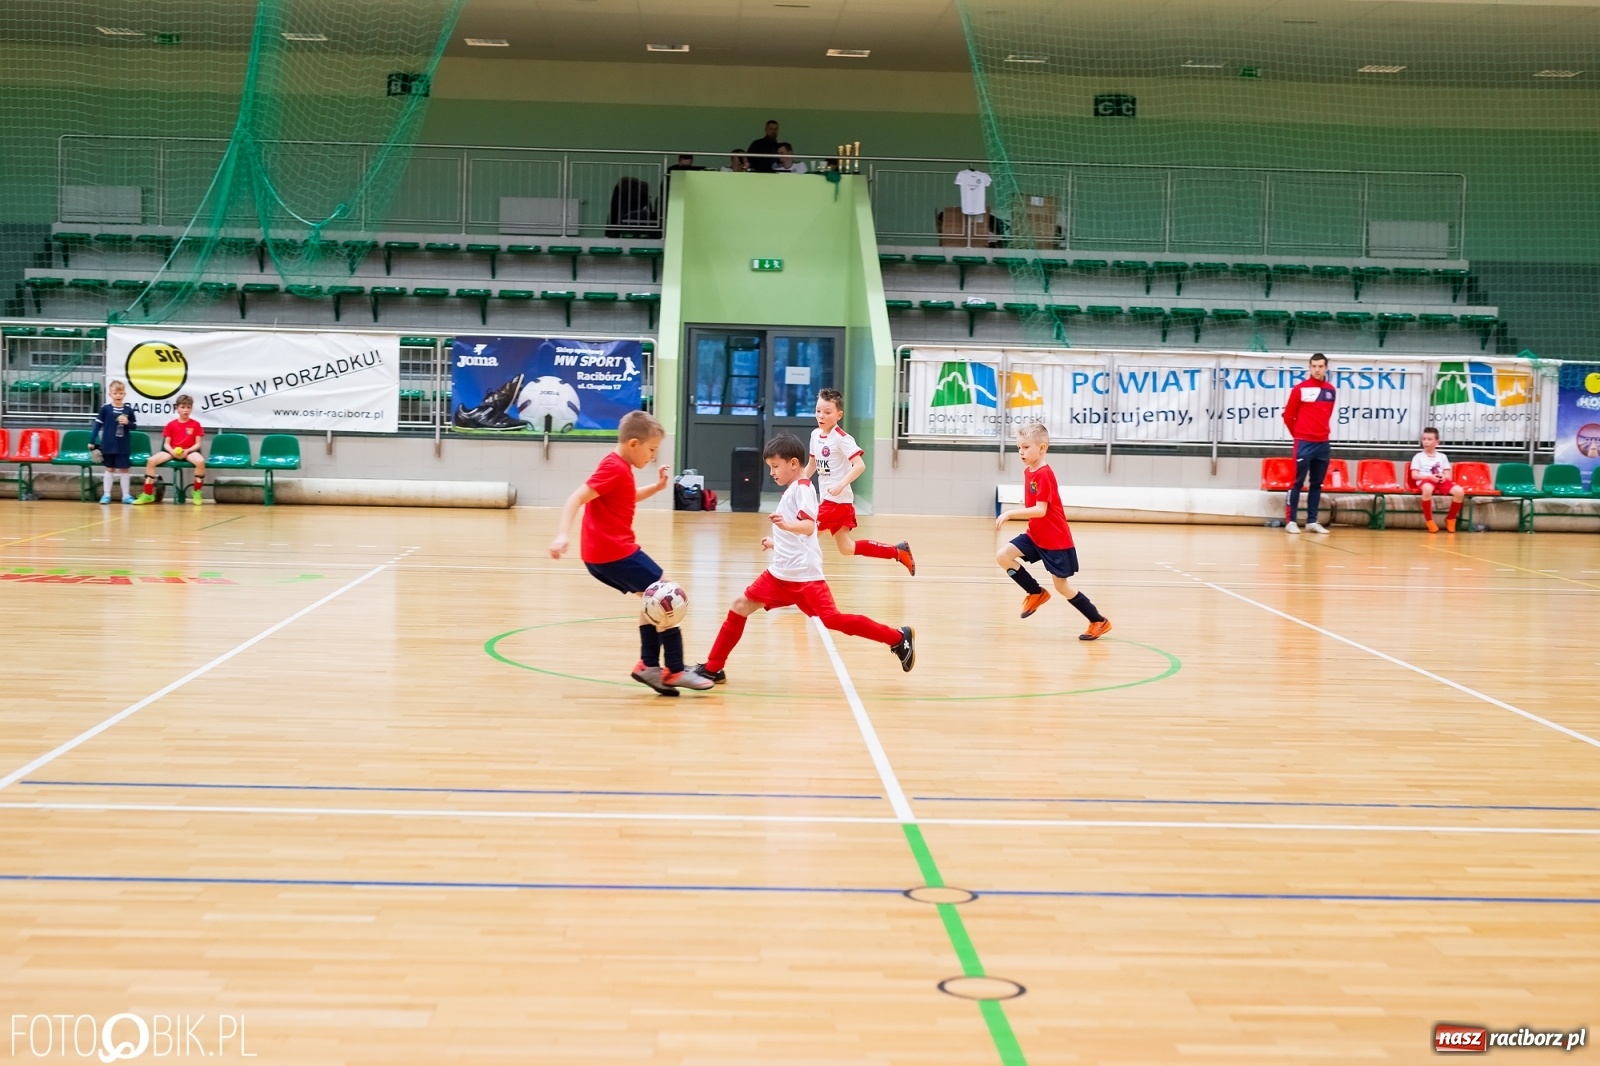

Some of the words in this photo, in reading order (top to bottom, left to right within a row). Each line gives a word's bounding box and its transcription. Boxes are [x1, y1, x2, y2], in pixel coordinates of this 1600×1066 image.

[554, 355, 578, 366] MW
[579, 356, 623, 367] SPORT
[201, 386, 244, 410] JEST
[249, 380, 267, 396] W
[272, 350, 382, 391] PORZĄDKU!
[577, 371, 622, 381] Racibórz
[1213, 367, 1406, 390] RACIBRSKI
[273, 408, 384, 420] www.osir-raciborz.pl
[929, 411, 973, 425] powiat
[982, 411, 1046, 424] racborski
[1070, 406, 1193, 427] kibicujemy,
[1338, 406, 1408, 424] gramy
